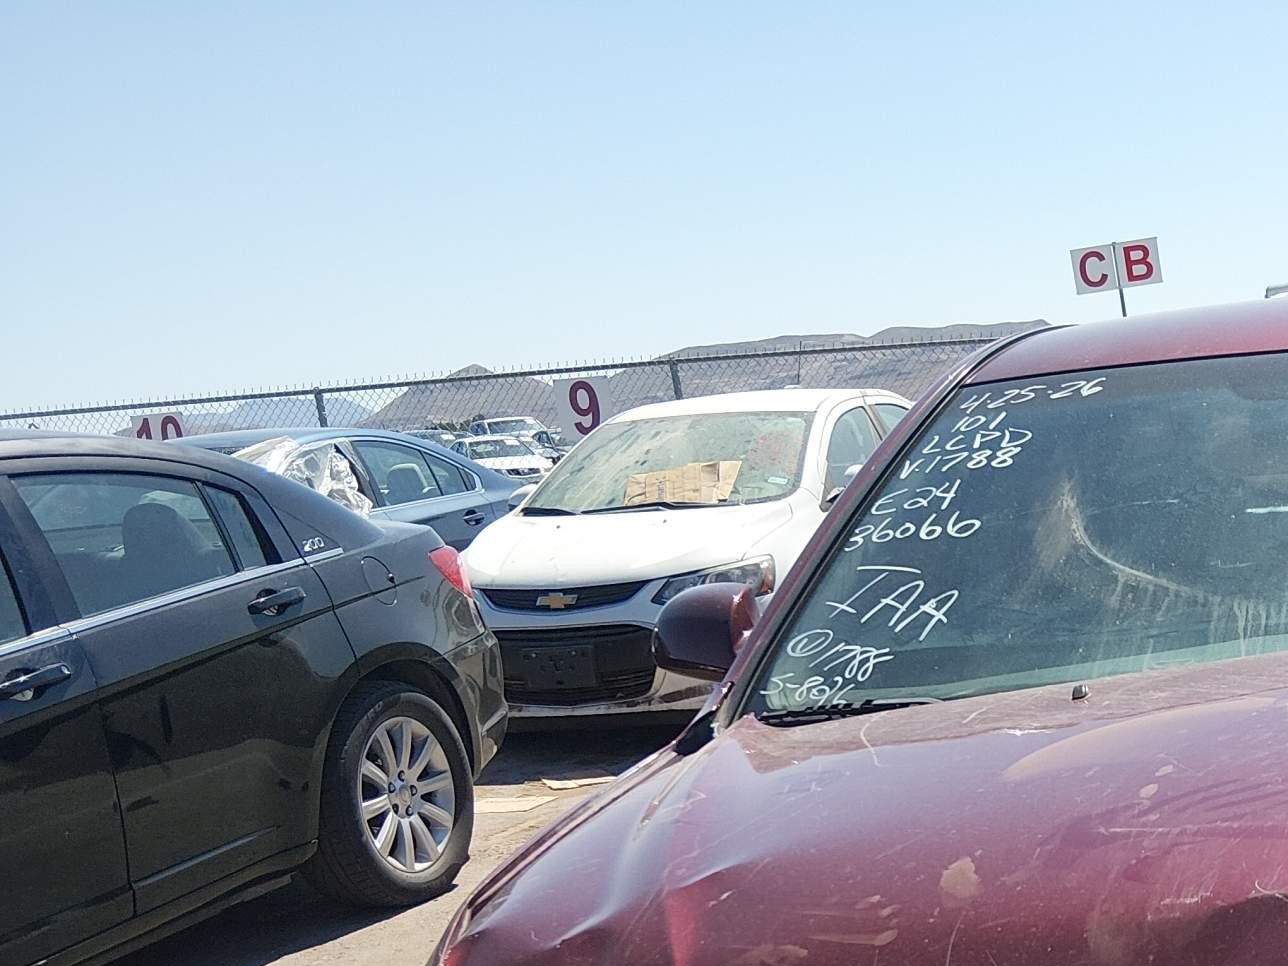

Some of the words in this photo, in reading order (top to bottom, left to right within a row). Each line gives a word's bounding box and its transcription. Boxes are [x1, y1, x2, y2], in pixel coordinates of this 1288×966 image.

[1079, 250, 1109, 288] C
[1122, 244, 1154, 283] B
[569, 380, 600, 436] 9
[951, 411, 1007, 432] 101
[922, 428, 1033, 454] LCPD
[302, 536, 325, 552] 200
[844, 511, 982, 551] 36066
